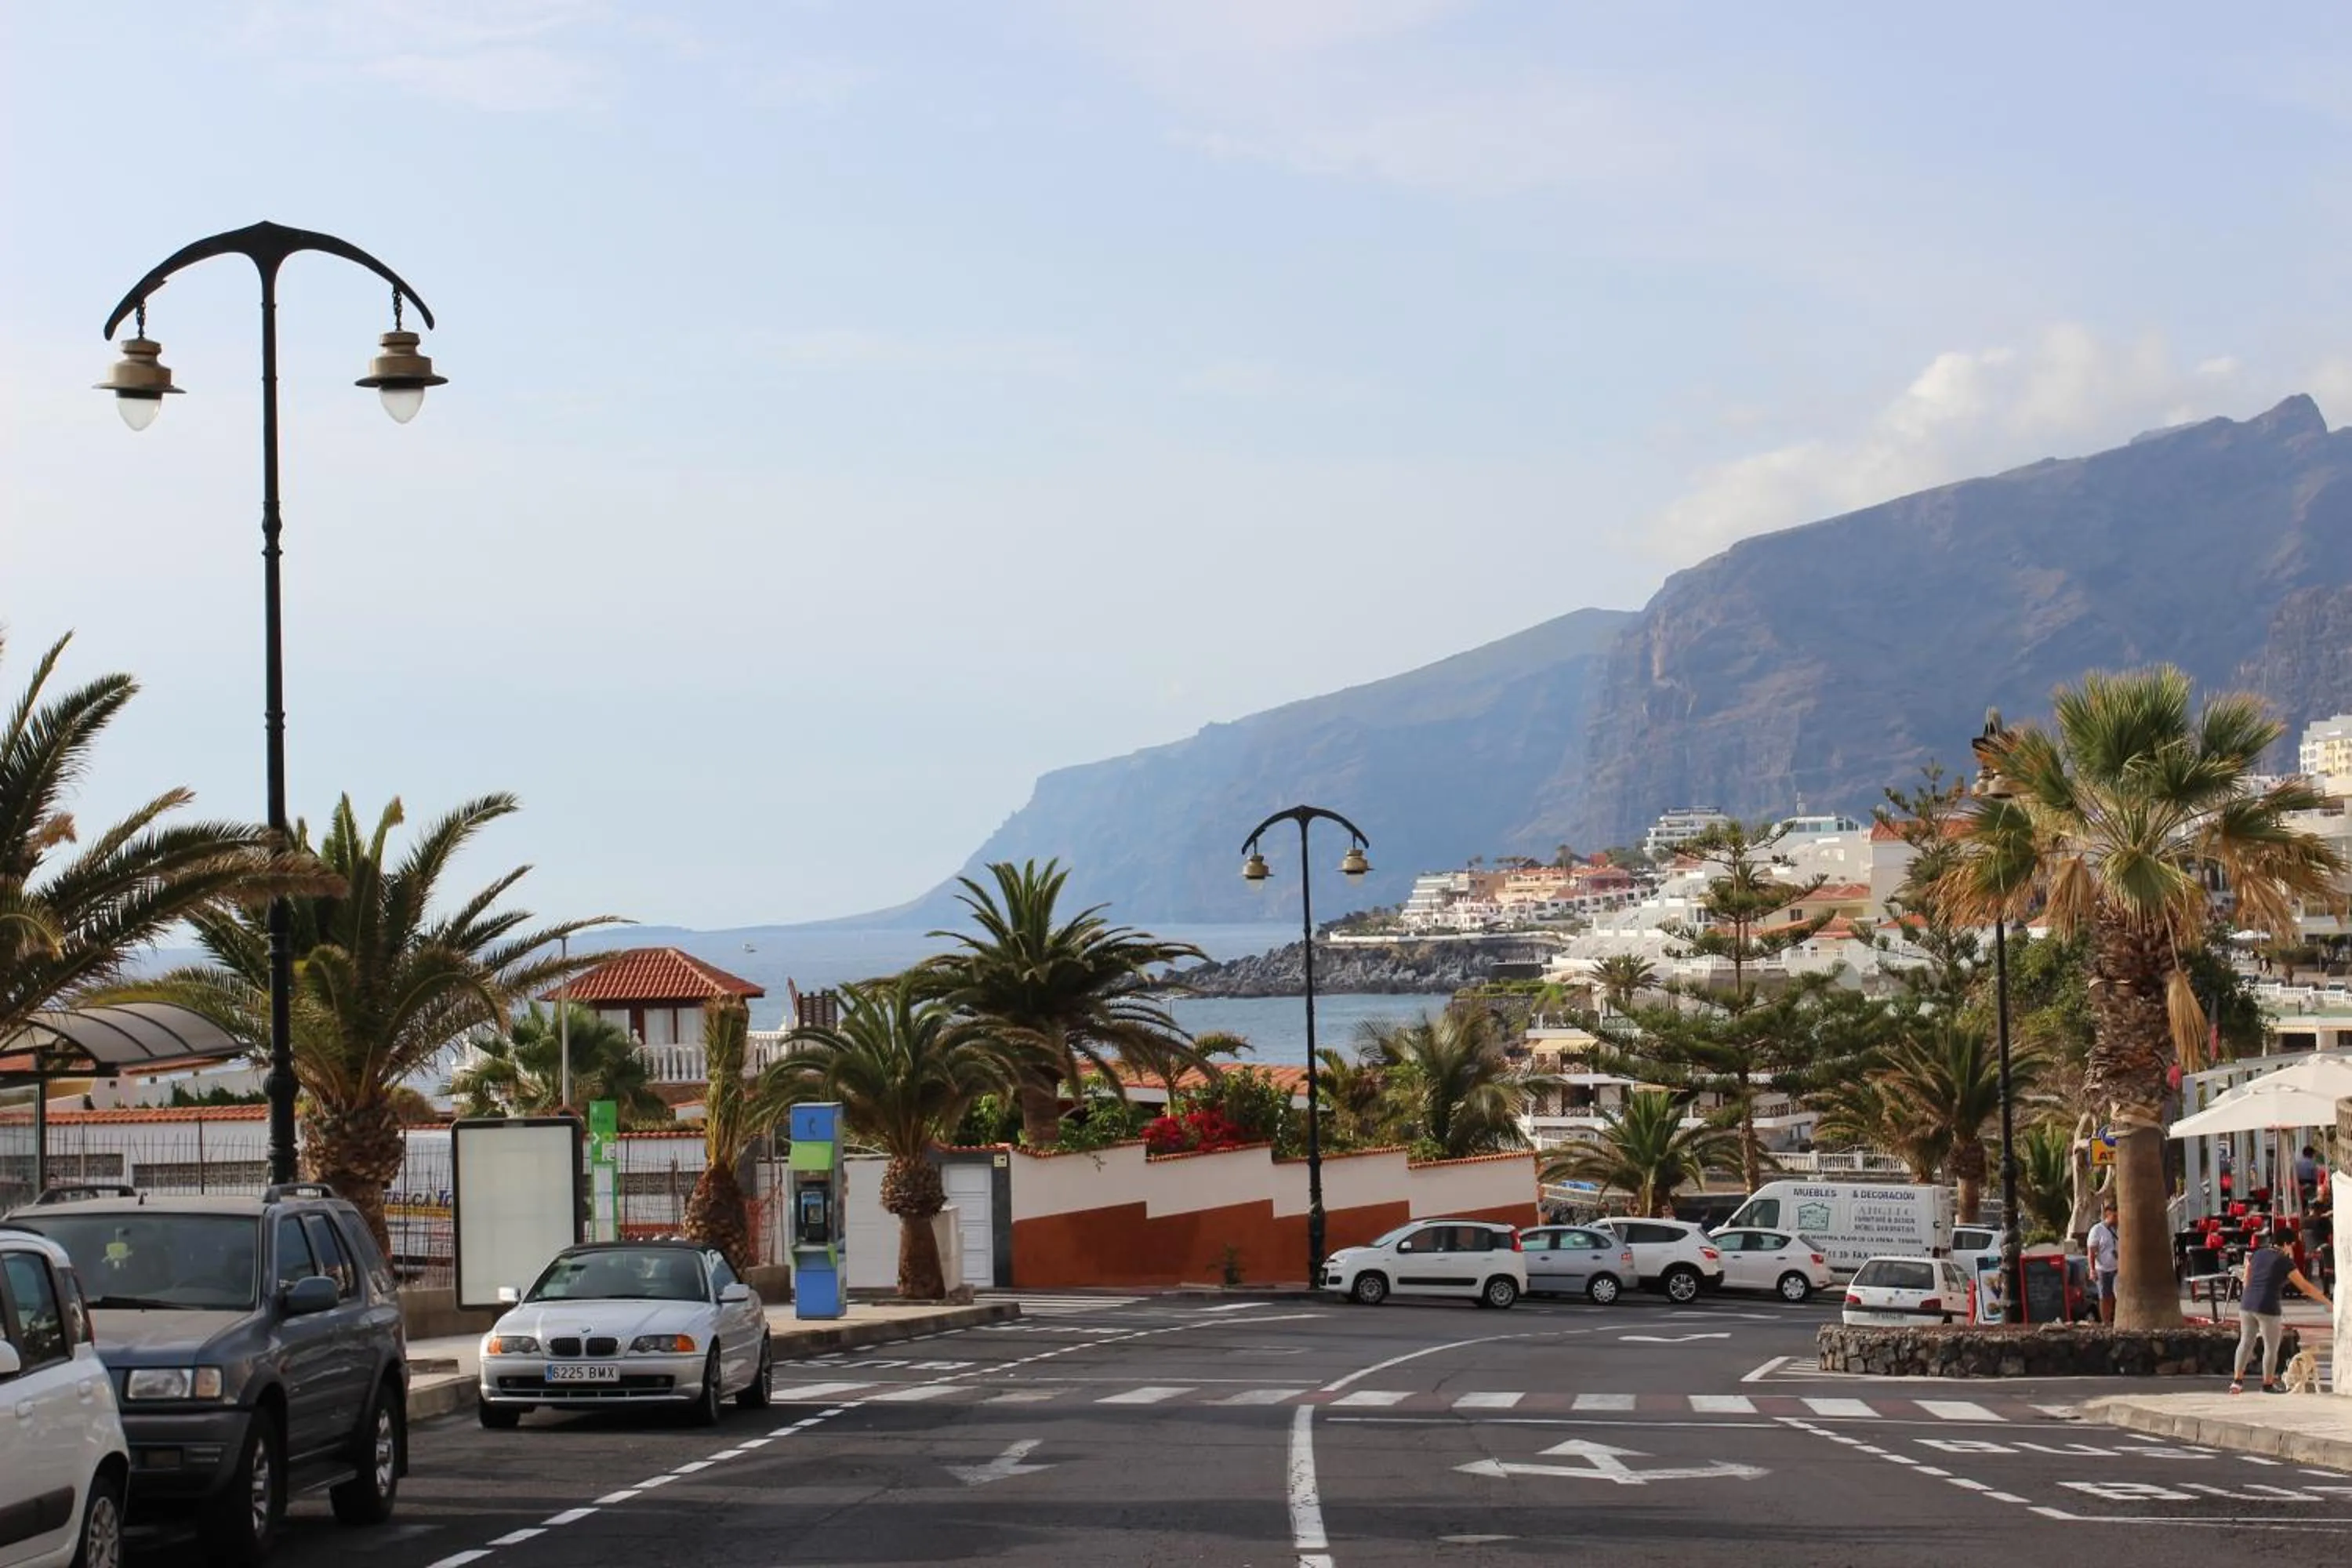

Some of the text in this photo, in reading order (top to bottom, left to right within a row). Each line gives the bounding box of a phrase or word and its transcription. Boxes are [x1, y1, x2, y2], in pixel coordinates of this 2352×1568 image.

[2098, 1151, 2115, 1161] AT
[1793, 1188, 1838, 1198] MUEBLES
[553, 1367, 615, 1379] 6225 BMX
[1913, 1438, 2218, 1459] BUS
